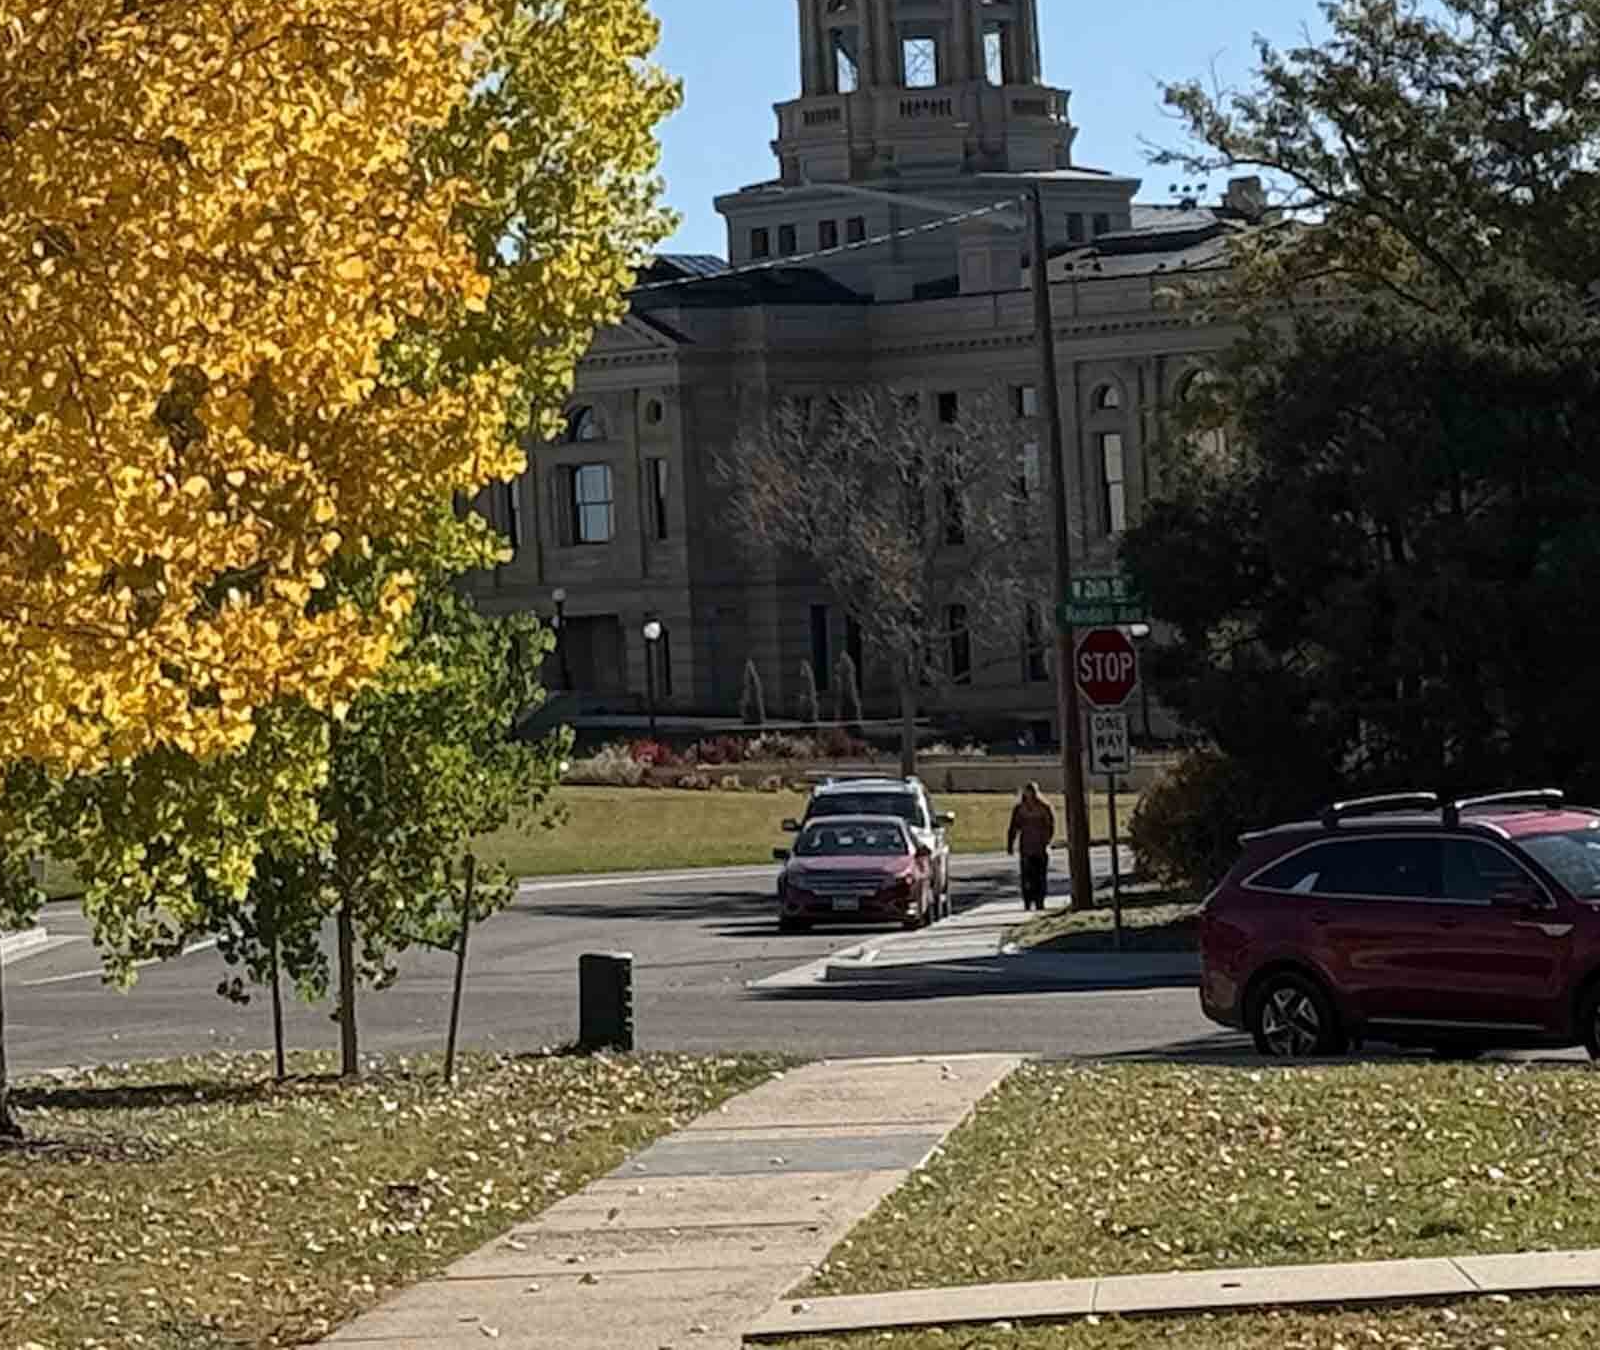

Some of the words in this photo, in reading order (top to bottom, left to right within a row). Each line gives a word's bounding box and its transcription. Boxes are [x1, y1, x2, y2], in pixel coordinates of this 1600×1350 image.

[1080, 652, 1134, 682] STOP
[1095, 716, 1122, 731] ONE
[1096, 735, 1123, 750] WAY
